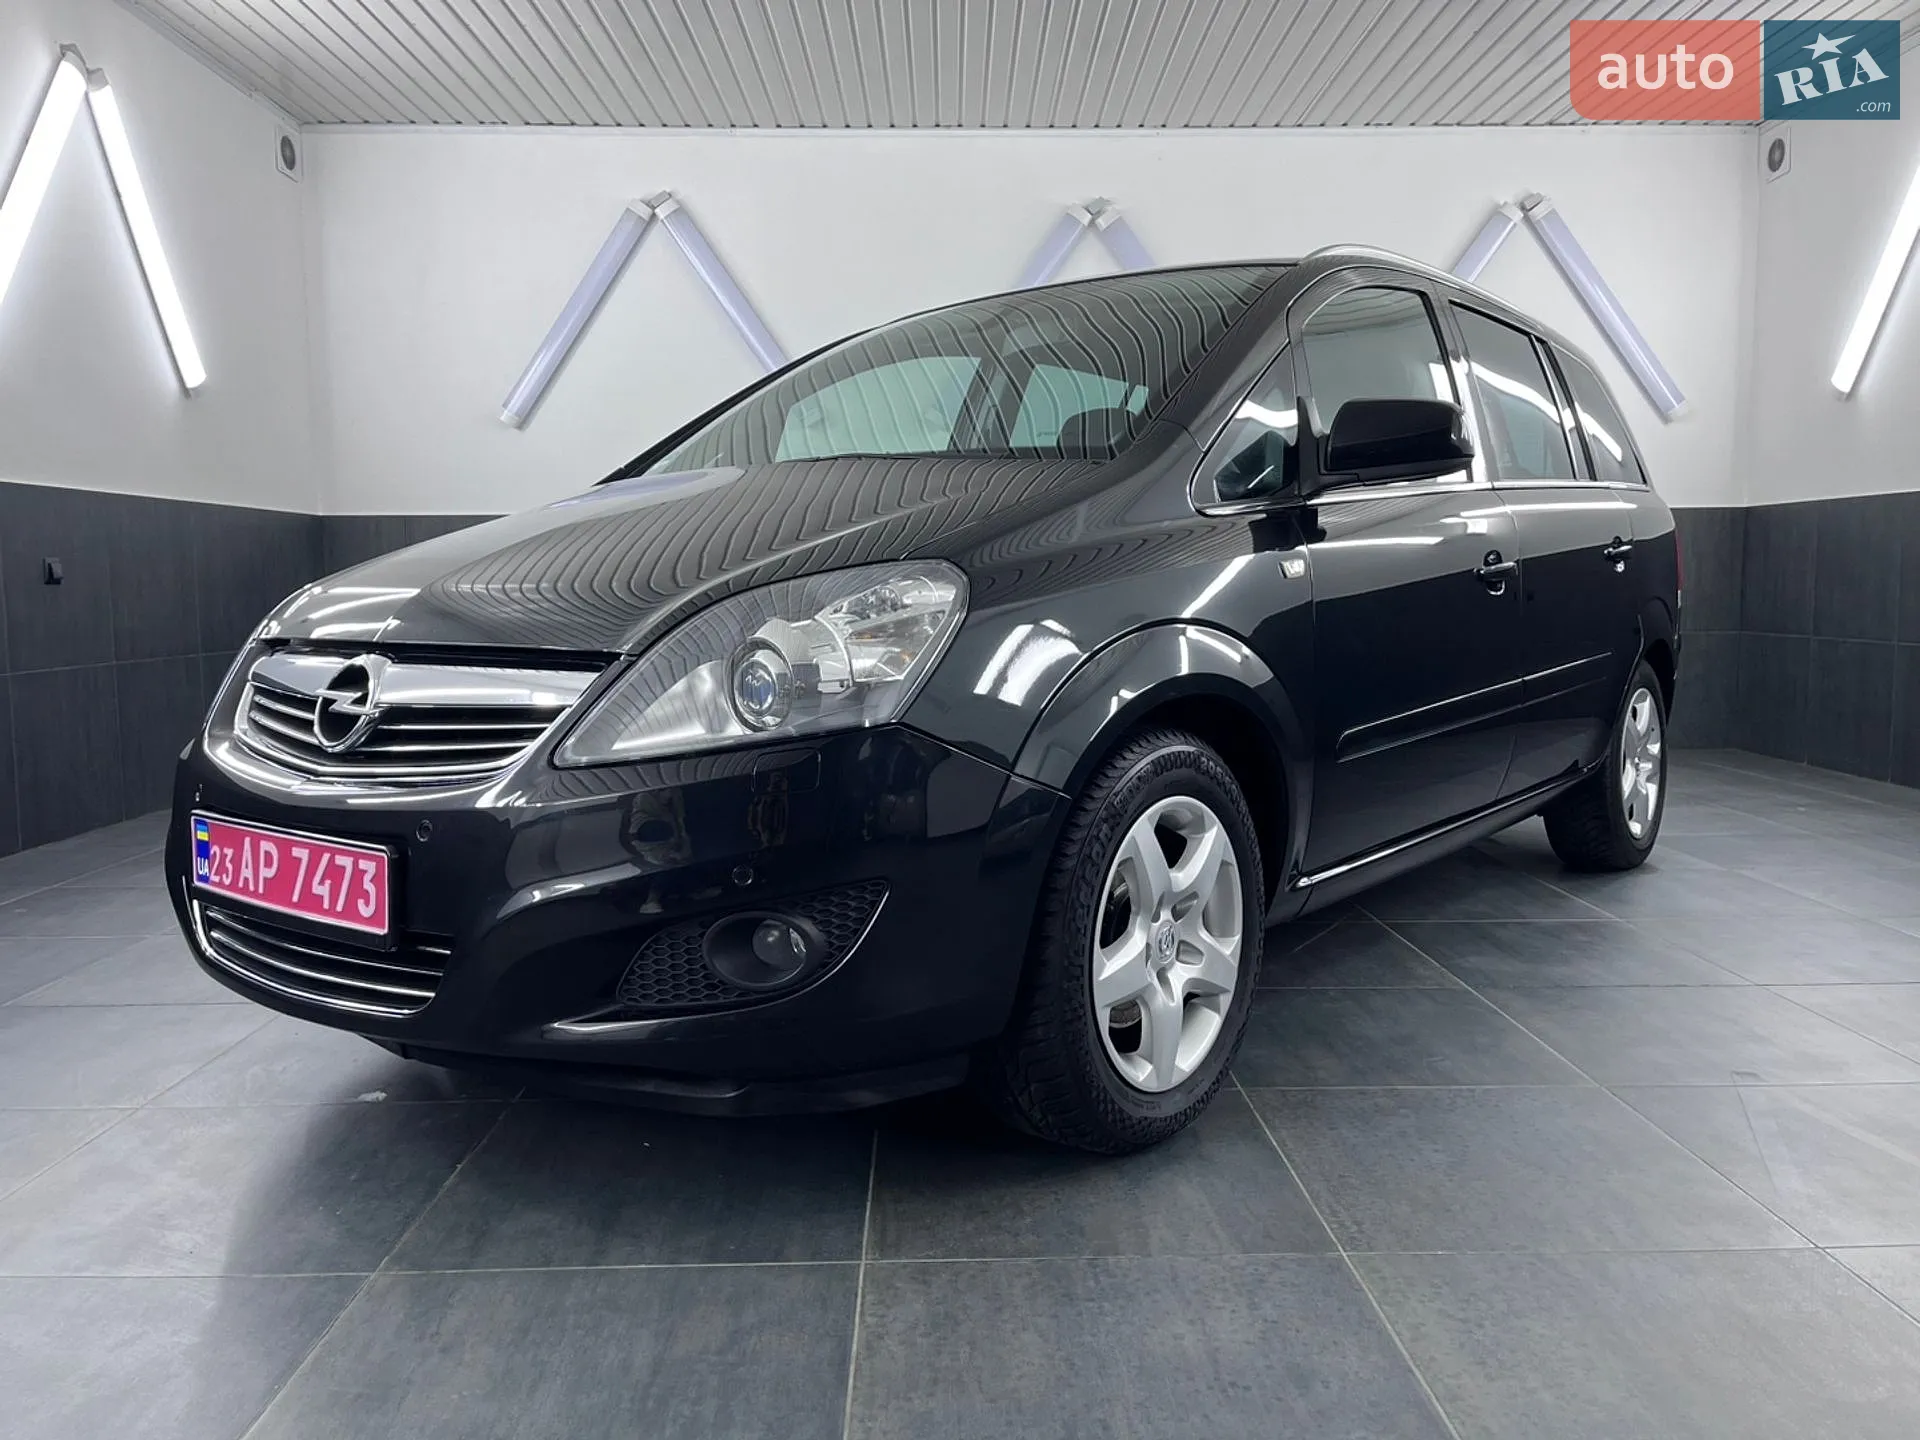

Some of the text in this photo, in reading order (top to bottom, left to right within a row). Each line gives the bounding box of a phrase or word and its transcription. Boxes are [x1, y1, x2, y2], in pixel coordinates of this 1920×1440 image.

[197, 856, 210, 877] UA
[209, 836, 377, 918] 23 AP 7473
